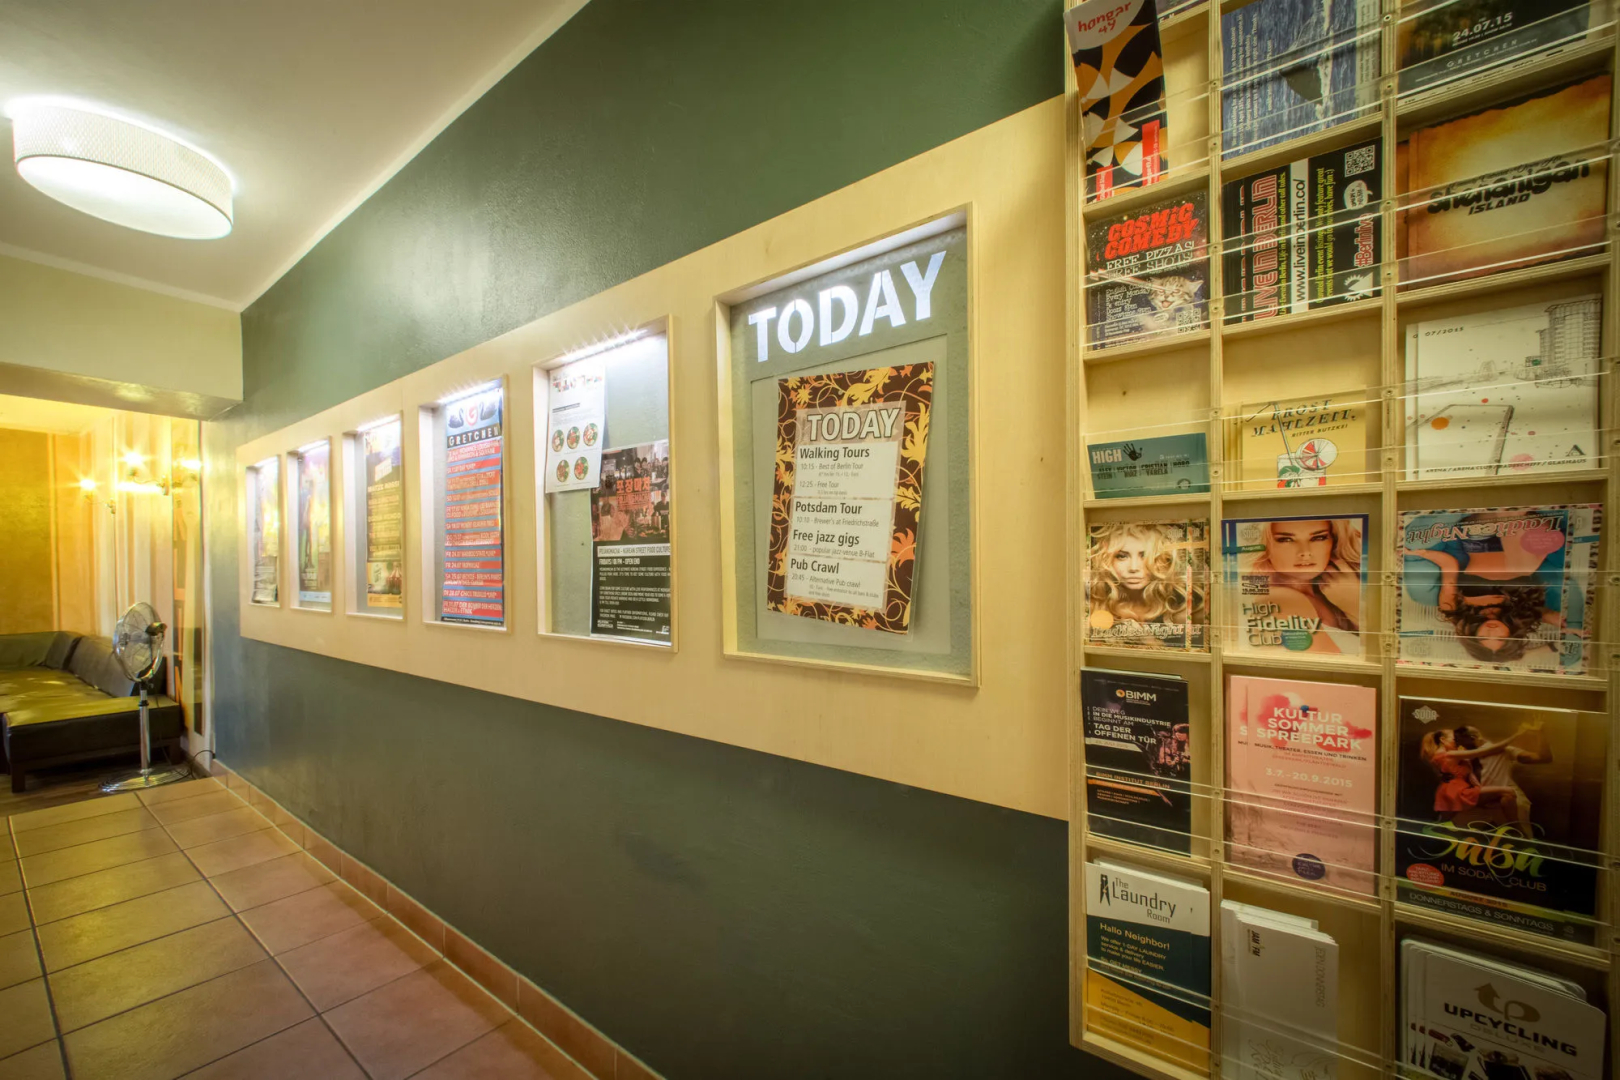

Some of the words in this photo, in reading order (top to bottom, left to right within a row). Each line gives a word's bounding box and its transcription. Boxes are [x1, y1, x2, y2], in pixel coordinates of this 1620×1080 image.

[1078, 1, 1131, 32] hangar
[1453, 11, 1513, 41] 24.07.15
[1468, 192, 1531, 216] ISLAND
[1104, 218, 1200, 260] COMEDY
[1106, 255, 1139, 271] FREE
[1146, 241, 1194, 260] PIZZAS!
[749, 251, 947, 362] TODAY
[1425, 326, 1464, 337] 07/2015
[807, 408, 901, 441] TODAY
[448, 426, 499, 446] GRETCHEN
[800, 446, 839, 461] Walking
[843, 446, 870, 458] Tours
[1092, 448, 1122, 464] HIGH
[837, 462, 852, 470] Berlin
[853, 462, 864, 470] Tour
[795, 501, 837, 514] Potsdam
[840, 502, 862, 514] Tour
[793, 529, 814, 541] Free
[815, 530, 835, 544] jazz
[838, 532, 860, 547] gigs
[790, 558, 808, 570] Pub
[811, 560, 839, 574] Crawl
[1242, 601, 1280, 616] High
[1247, 614, 1322, 635] Fidelity
[1248, 632, 1283, 647] Club
[1125, 690, 1157, 702] BIMM
[1093, 716, 1122, 725] BEGINNT
[1114, 713, 1171, 727] MUSIKINDUSTRIE
[1273, 707, 1342, 724] KULTUR
[1093, 722, 1111, 732] TAG
[1113, 725, 1131, 734] DER
[1268, 718, 1349, 737] SOMMER
[1094, 729, 1136, 742] OFFENEN
[1138, 734, 1157, 745] TÜR
[1256, 728, 1362, 750] SPREEPARK
[1339, 753, 1367, 761] TRINKEN
[1414, 821, 1546, 878] Salsa
[1115, 877, 1129, 889] The
[1441, 863, 1455, 873] IM
[1458, 866, 1495, 881] SODA
[1509, 876, 1547, 891] CLUB
[1112, 881, 1176, 918] Laundry
[1147, 908, 1171, 924] Room
[1409, 892, 1482, 915] DONNERSTAGS
[1494, 911, 1554, 932] SONNTAGS
[1100, 923, 1122, 937] Hallo
[1125, 926, 1170, 950] Neighbor!
[1444, 1002, 1578, 1057] UPCYCLING
